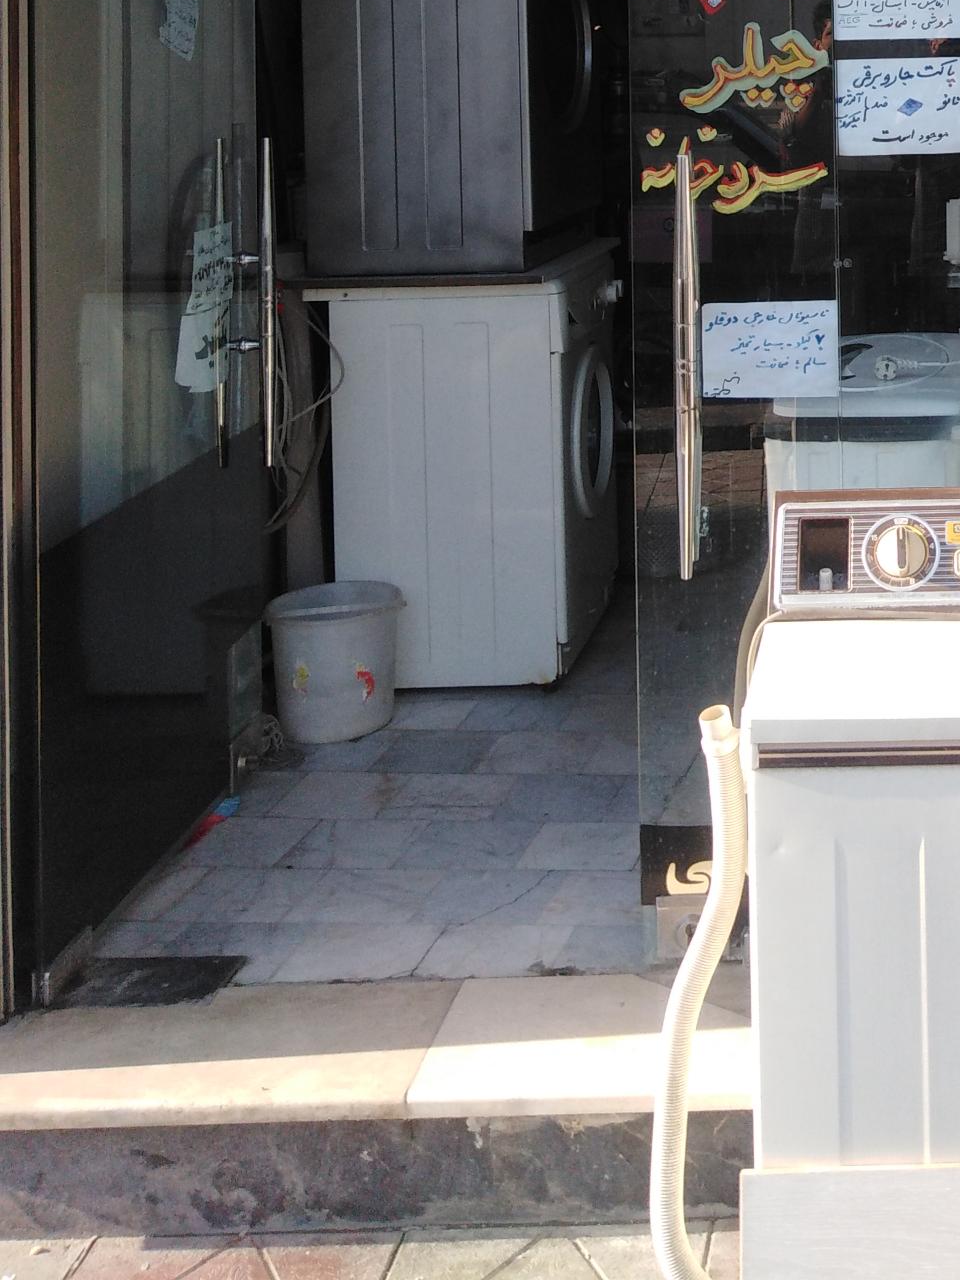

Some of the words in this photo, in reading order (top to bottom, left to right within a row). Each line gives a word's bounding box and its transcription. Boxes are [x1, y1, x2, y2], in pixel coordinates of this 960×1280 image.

[869, 15, 908, 28] ضمانت
[679, 22, 829, 113] چیلر
[917, 59, 958, 87] پاکت
[872, 129, 915, 143] است
[918, 131, 948, 145] موجود
